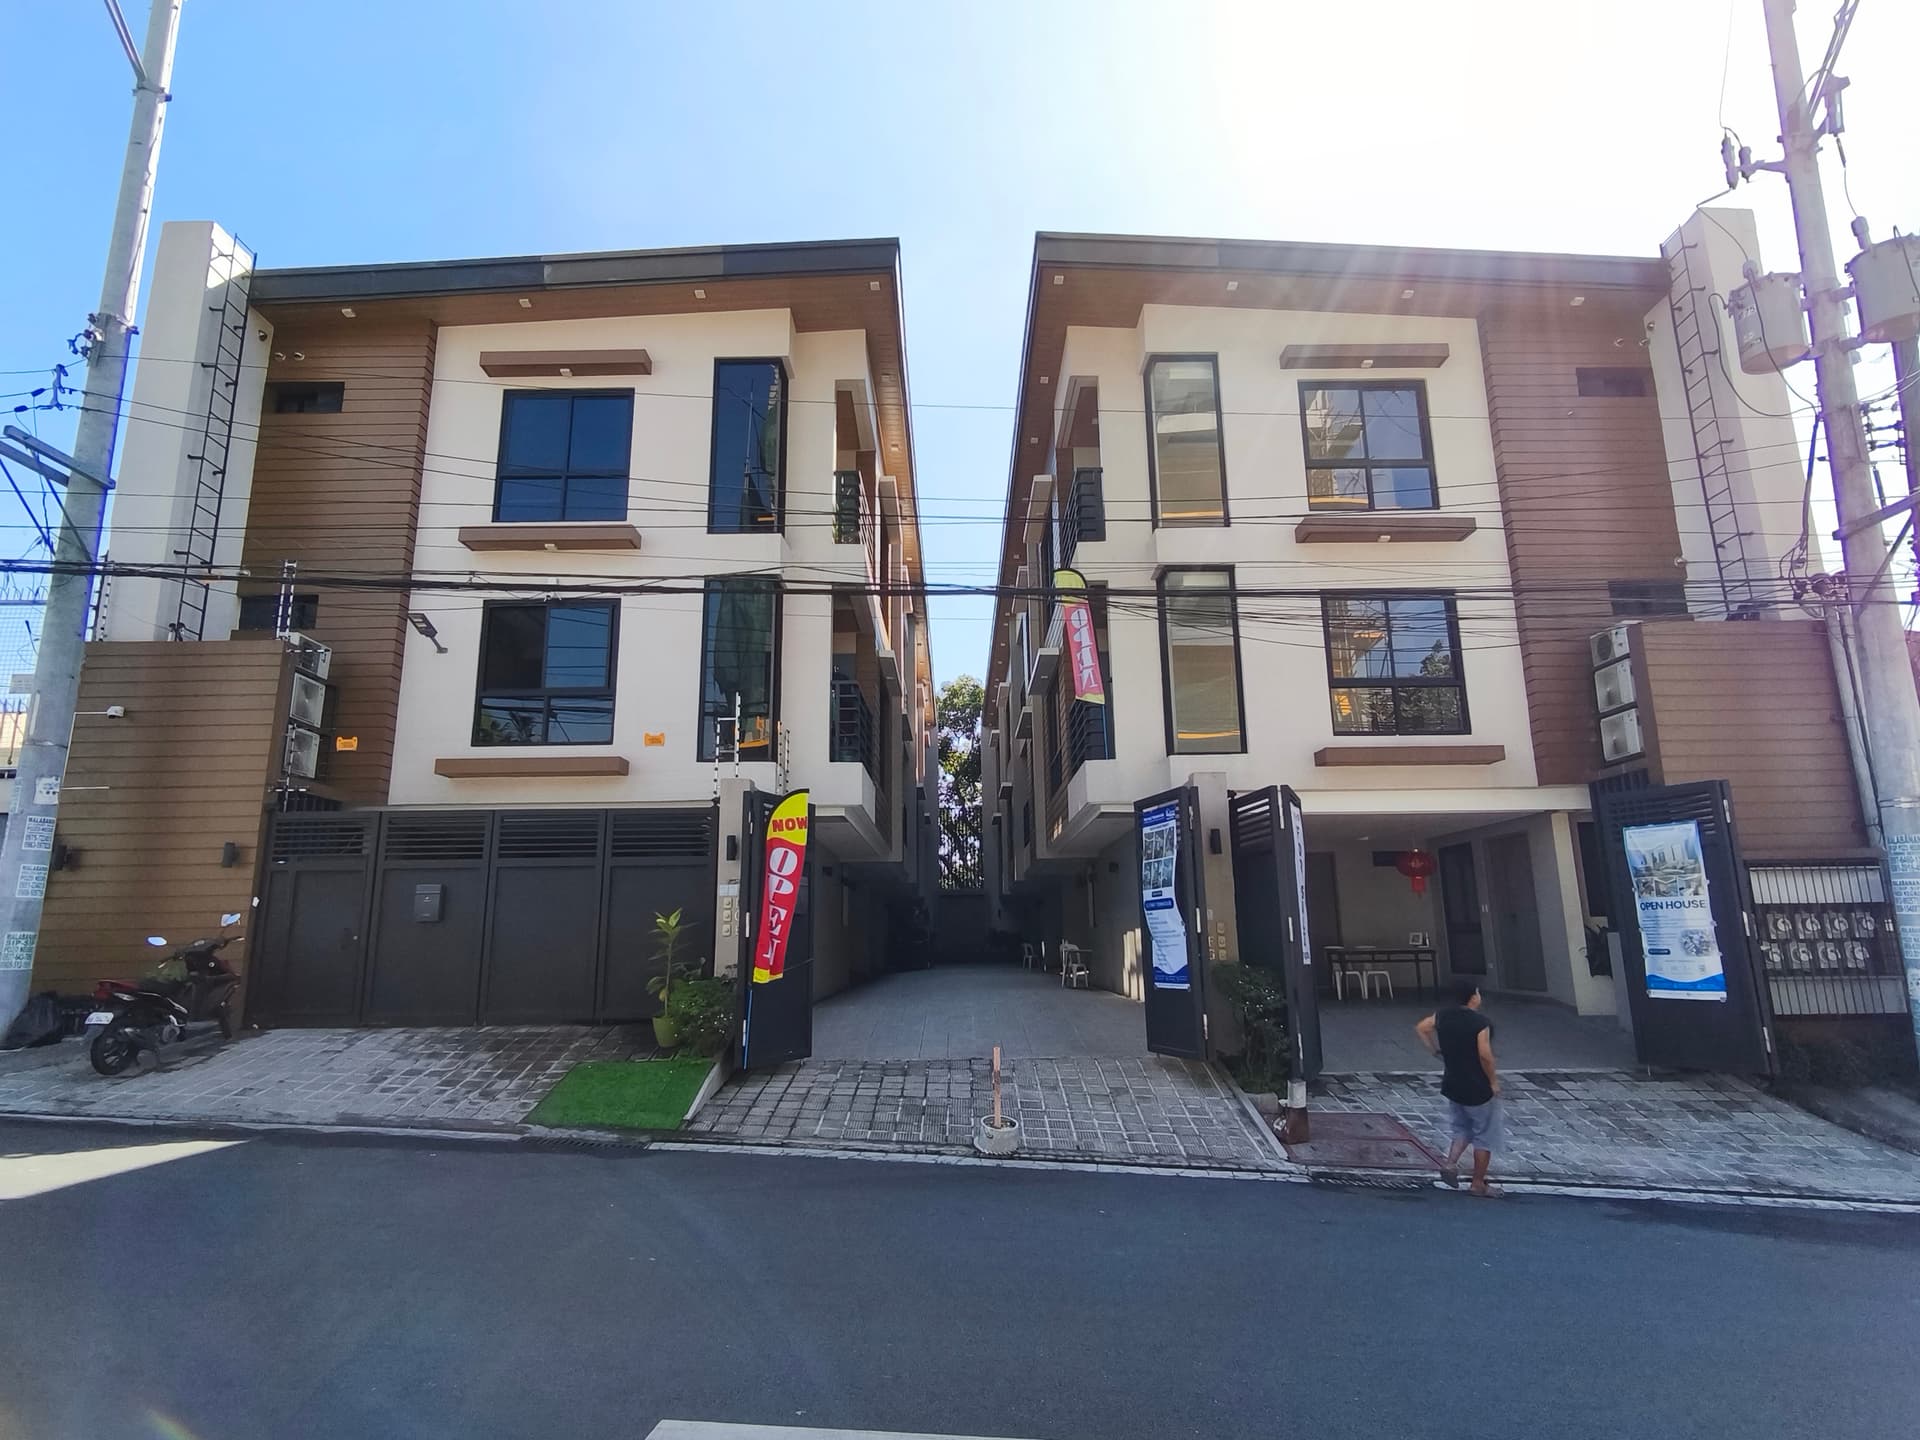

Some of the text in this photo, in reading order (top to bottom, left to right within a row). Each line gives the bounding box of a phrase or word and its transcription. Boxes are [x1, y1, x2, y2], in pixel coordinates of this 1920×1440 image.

[771, 815, 808, 833] NOW
[1640, 899, 1707, 911] OPEN HOUSE
